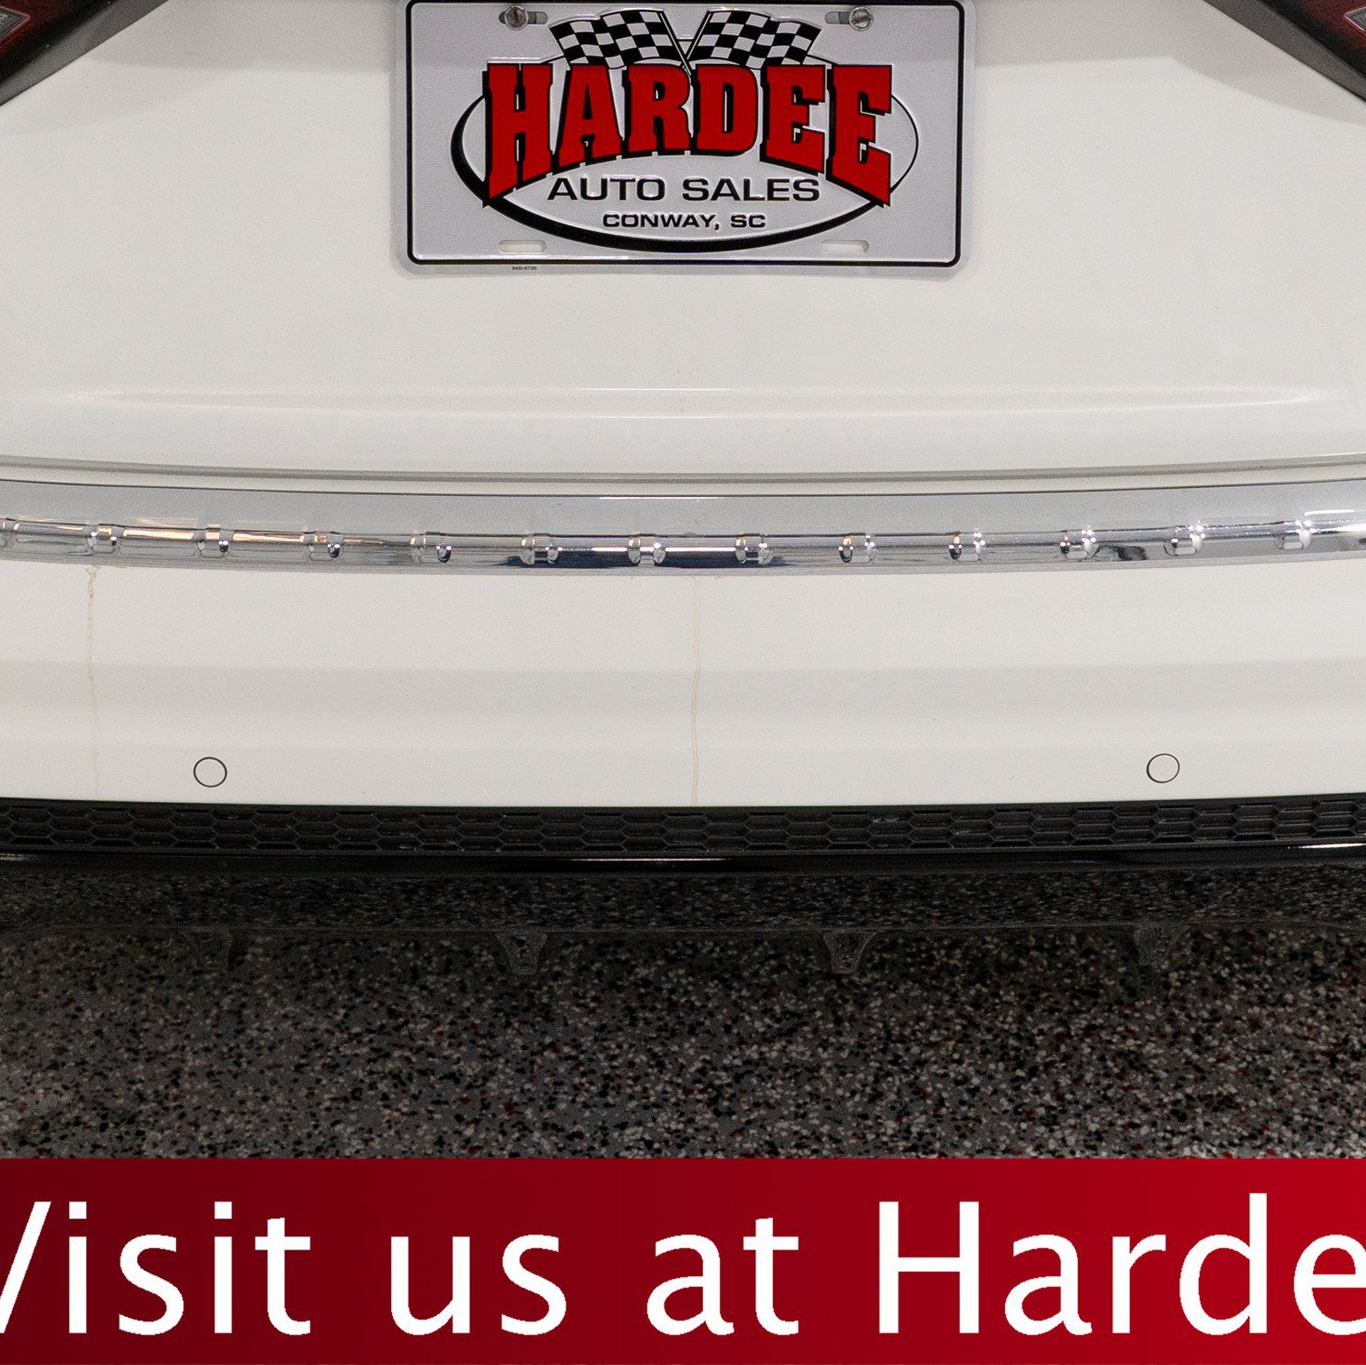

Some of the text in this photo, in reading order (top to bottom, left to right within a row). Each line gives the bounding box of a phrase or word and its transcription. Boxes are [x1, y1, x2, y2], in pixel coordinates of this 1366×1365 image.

[481, 62, 892, 208] HARDEE
[547, 176, 820, 202] AUTO SALES
[602, 213, 766, 231] CONWAY, SC
